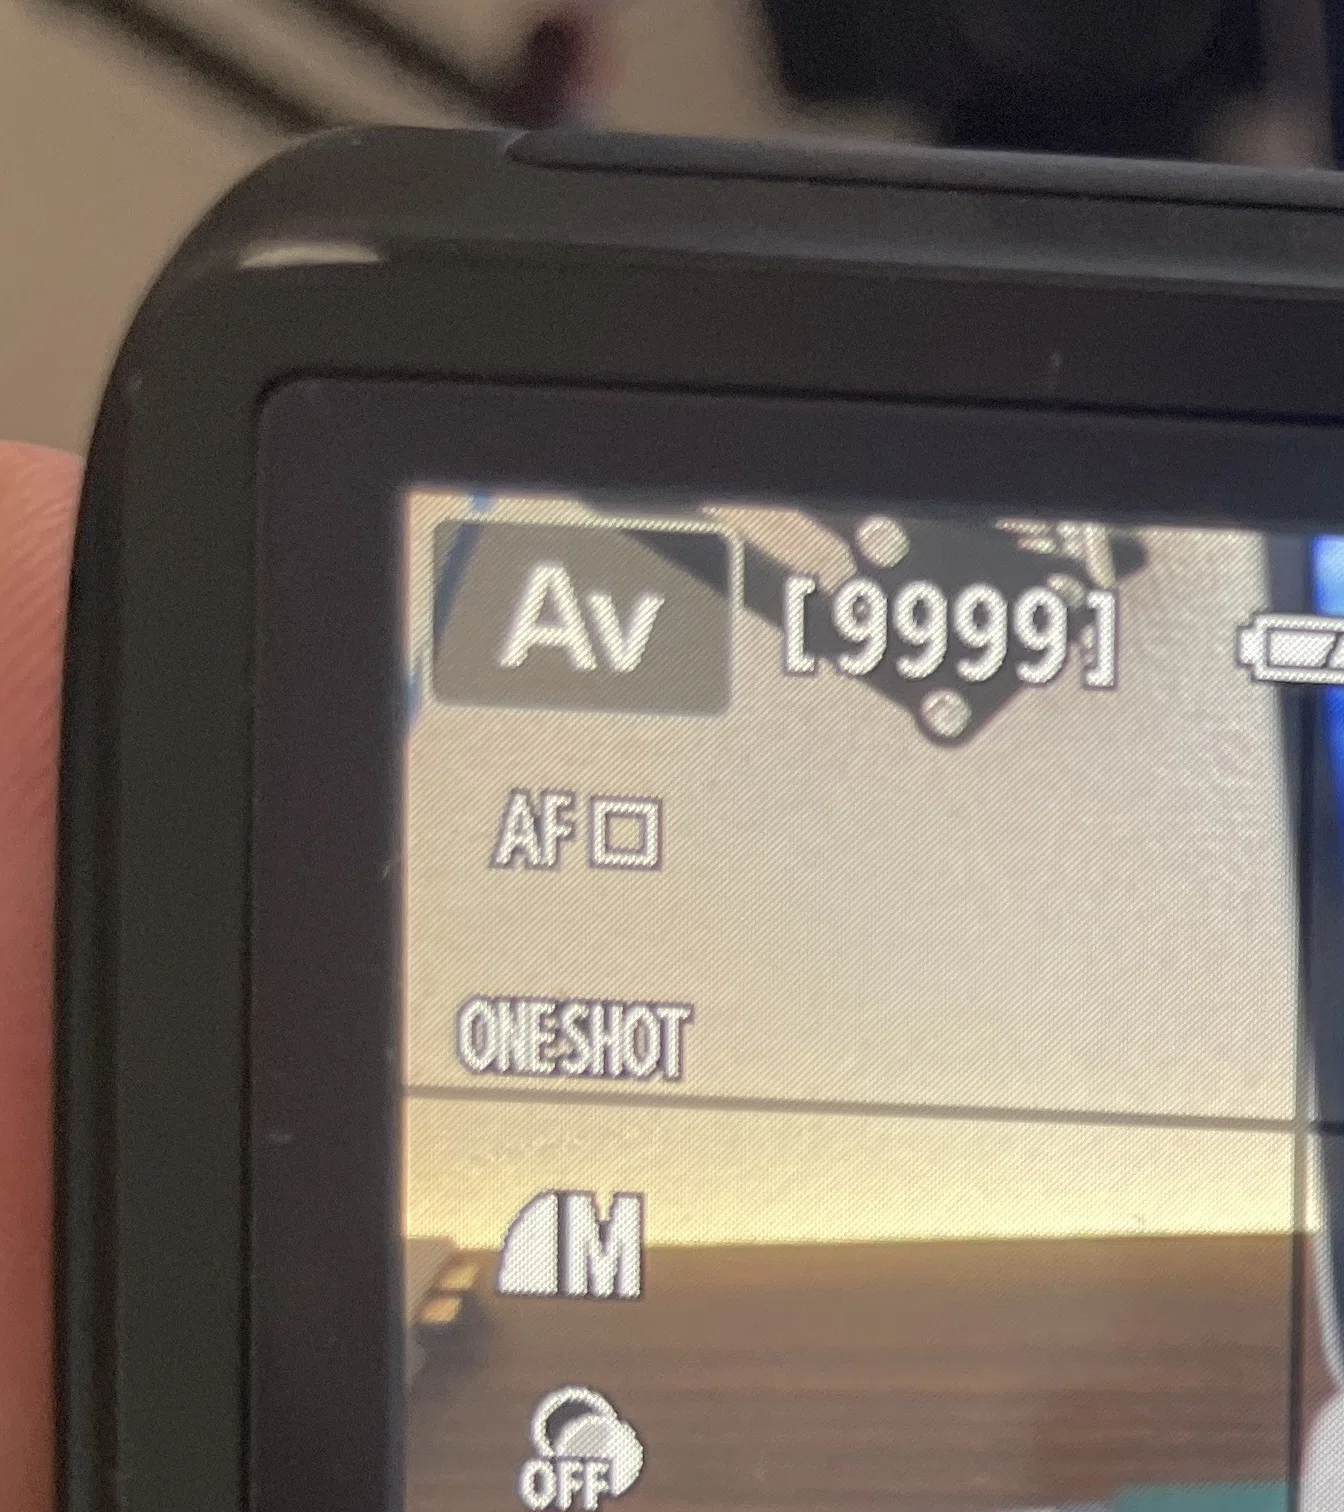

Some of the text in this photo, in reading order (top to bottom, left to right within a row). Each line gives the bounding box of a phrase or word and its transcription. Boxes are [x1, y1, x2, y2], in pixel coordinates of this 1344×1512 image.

[497, 562, 664, 673] Av
[783, 577, 1119, 689] [9999]
[491, 790, 576, 868] AF
[518, 1457, 611, 1512] OFF
